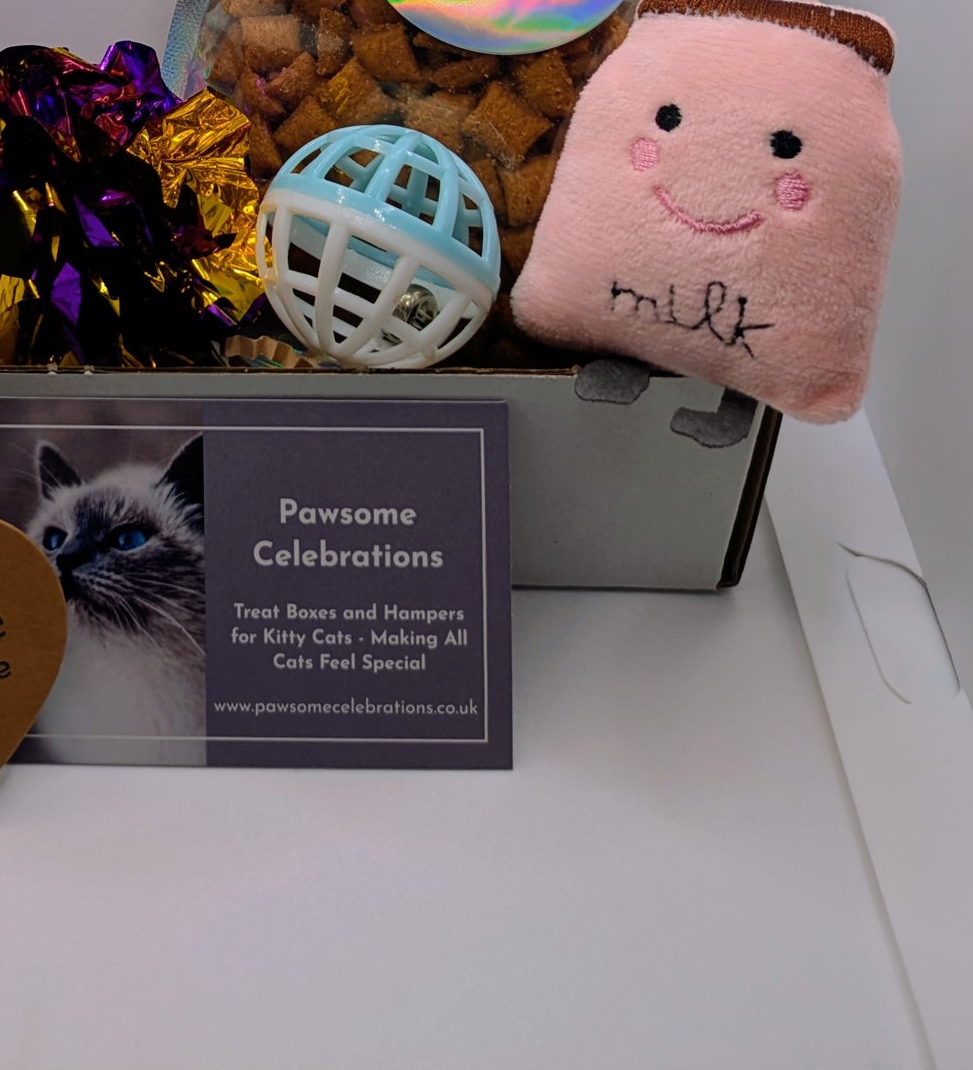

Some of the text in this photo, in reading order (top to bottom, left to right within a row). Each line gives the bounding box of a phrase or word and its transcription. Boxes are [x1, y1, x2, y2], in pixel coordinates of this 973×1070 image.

[610, 281, 776, 358] milk
[279, 497, 417, 526] Pawsome
[252, 538, 444, 568] Celebrations
[233, 602, 465, 625] Treat Boxes and Hampers
[230, 627, 257, 644] for
[263, 628, 306, 648] Kitty
[312, 629, 353, 646] Cats
[370, 629, 438, 649] Making
[443, 629, 468, 646] All
[273, 653, 427, 673] Cats Feel Special
[213, 697, 478, 716] www.pawsomecelebrations.co.uk
